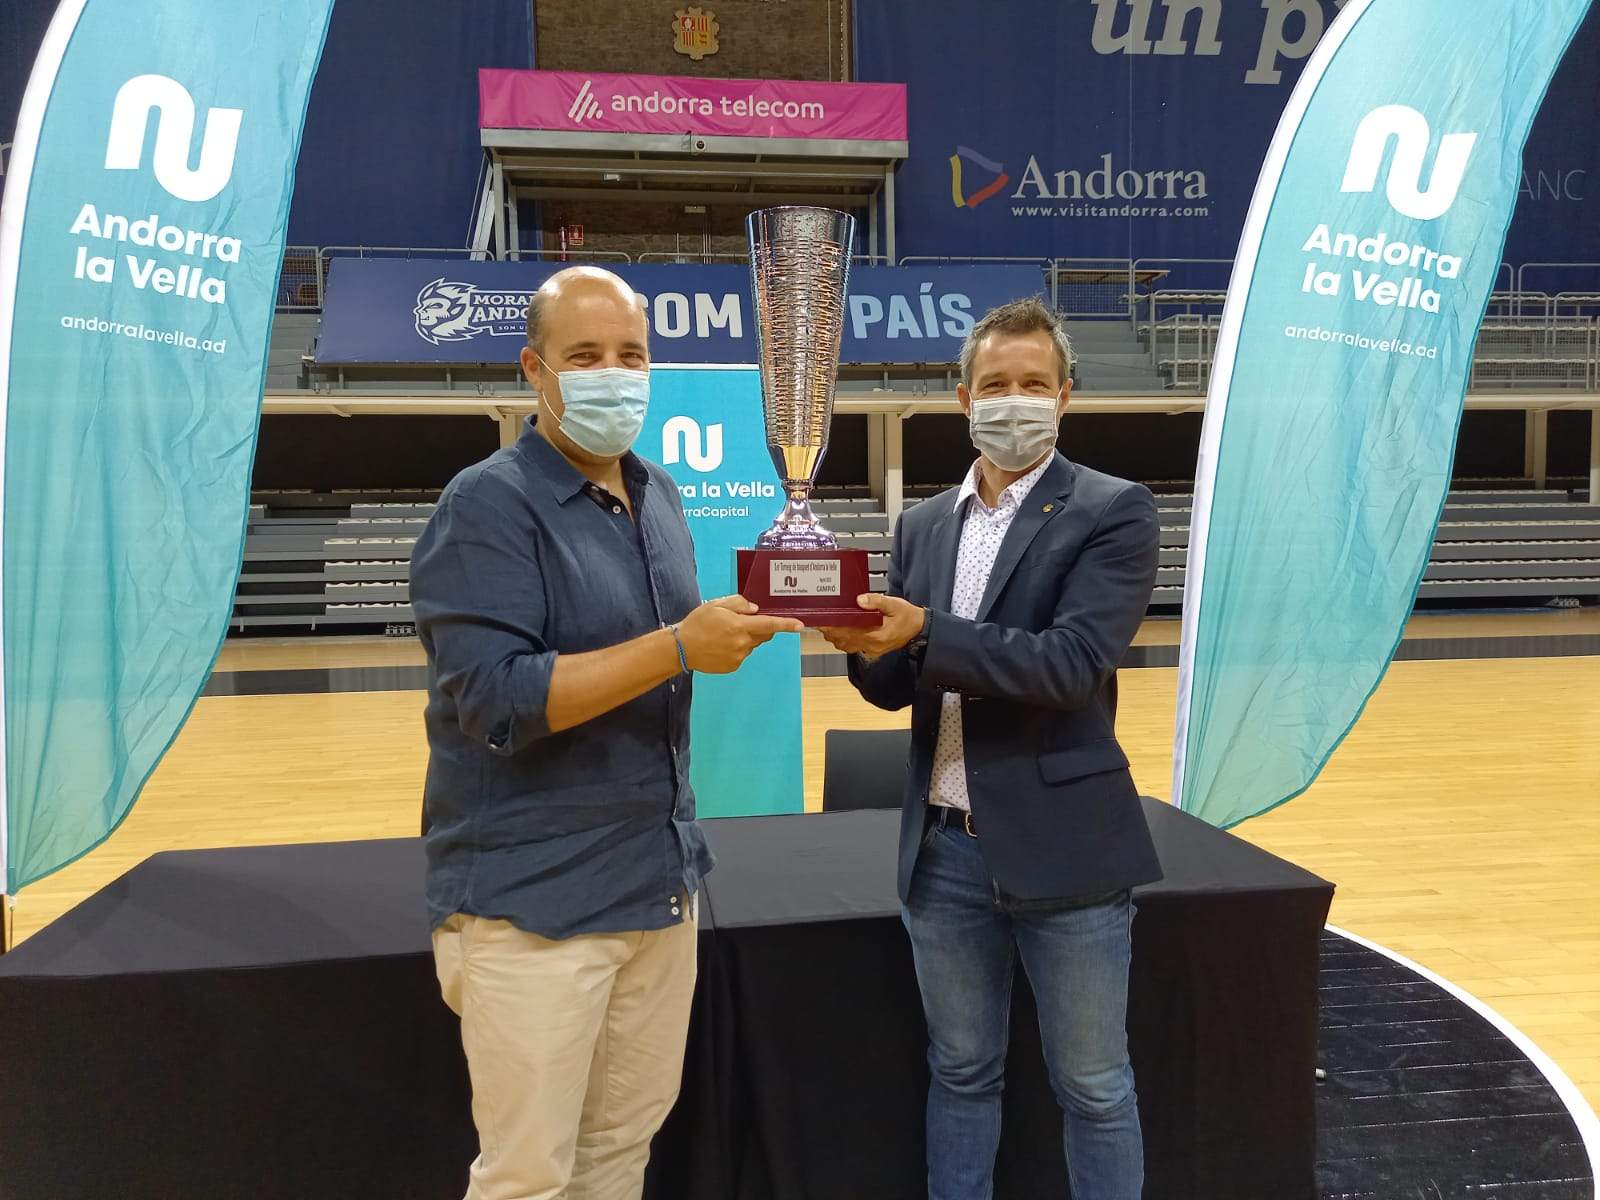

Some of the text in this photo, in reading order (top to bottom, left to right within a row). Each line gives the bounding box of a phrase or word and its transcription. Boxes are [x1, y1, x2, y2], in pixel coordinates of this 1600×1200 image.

[1091, 0, 1222, 55] un
[611, 91, 824, 119] andorra telecom
[1011, 152, 1209, 200] Andorra
[69, 203, 241, 263] Andorra
[1011, 203, 1209, 217] www.visitandorra.com
[75, 246, 226, 304] la Vella
[1301, 223, 1463, 279] Andorra
[849, 282, 976, 339] PAÍS
[1302, 262, 1441, 314] la Vella
[61, 315, 227, 353] andorralavella.ad
[1285, 325, 1437, 359] andorralavella.ad
[702, 481, 720, 498] la
[725, 481, 775, 498] Vella
